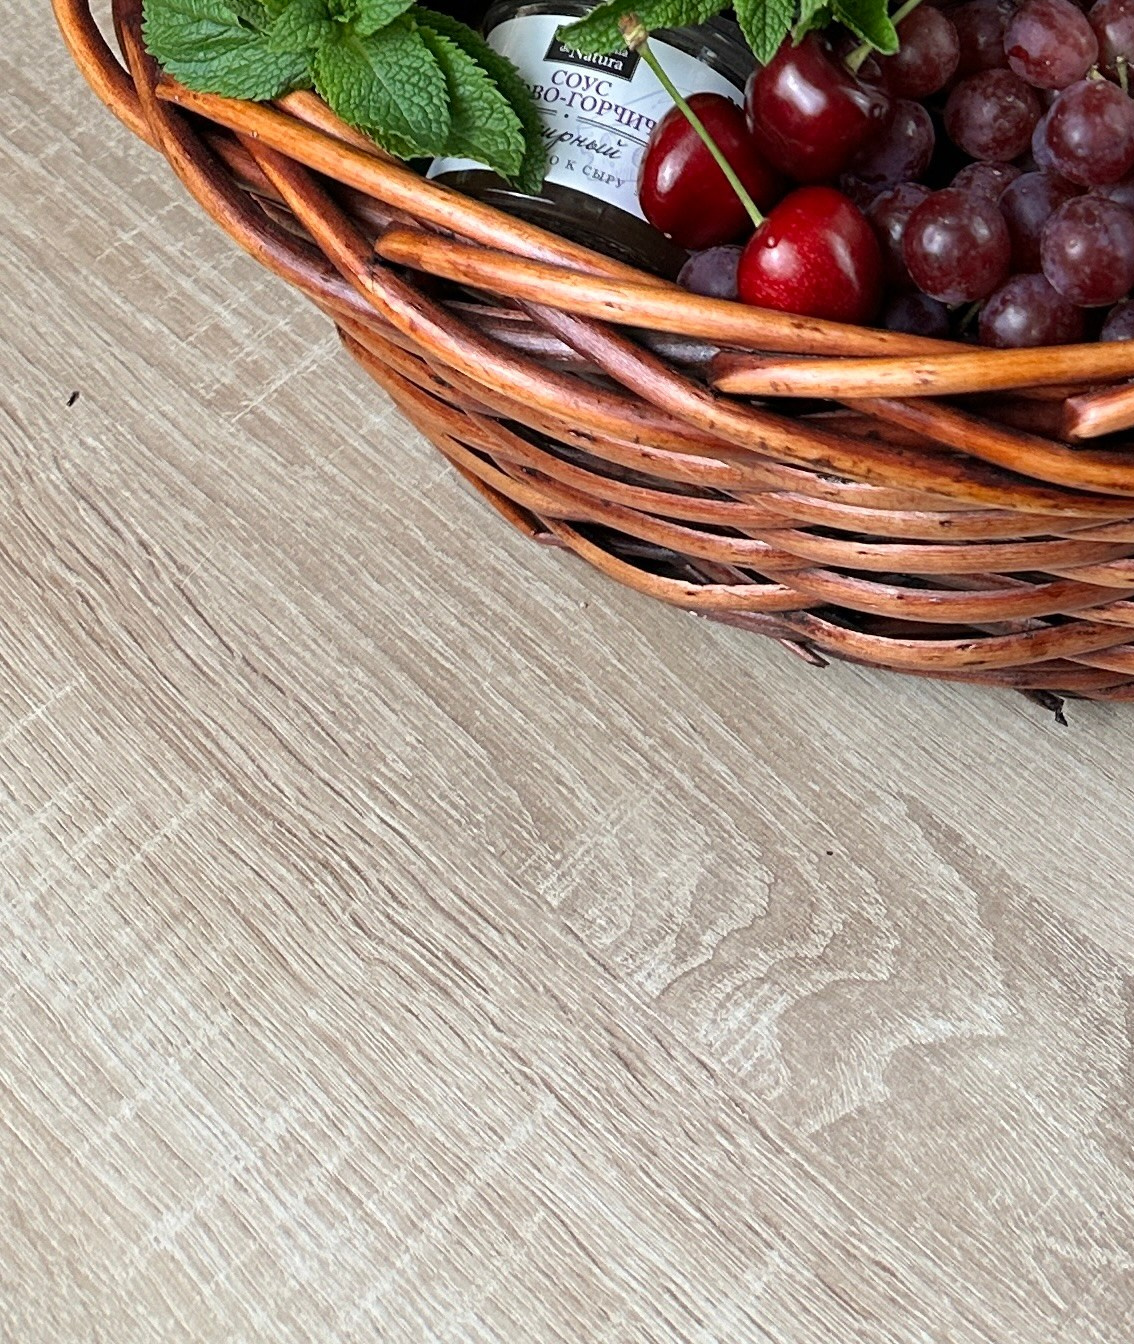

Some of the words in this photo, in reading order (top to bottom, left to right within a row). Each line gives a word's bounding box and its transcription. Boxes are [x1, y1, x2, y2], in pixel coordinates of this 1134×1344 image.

[551, 69, 613, 97] СОУС
[526, 84, 657, 136] ВО-ГОРЧИЧ
[582, 165, 626, 189] СЫРУ
